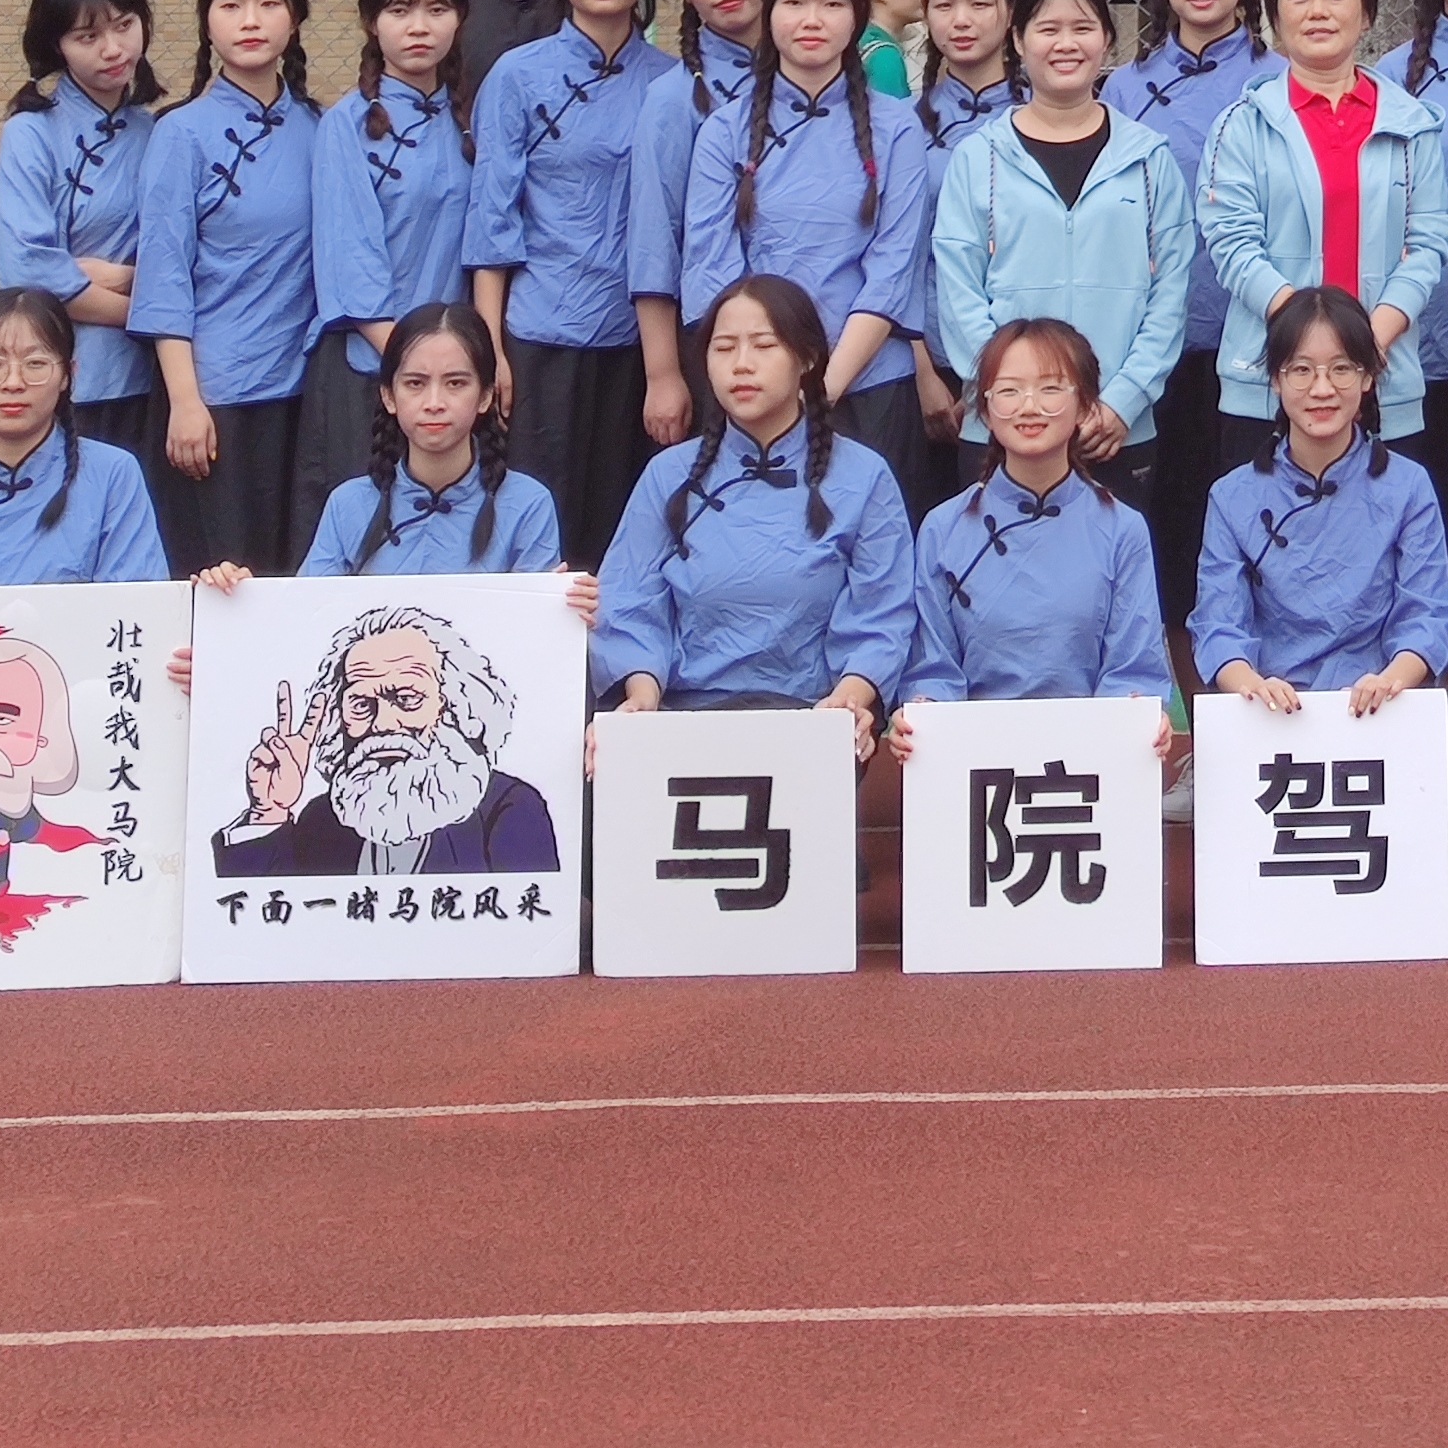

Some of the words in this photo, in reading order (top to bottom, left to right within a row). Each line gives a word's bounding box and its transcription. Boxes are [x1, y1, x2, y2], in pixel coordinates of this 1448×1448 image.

[100, 618, 144, 886] 壮哉我大马院
[655, 775, 792, 912] 马
[968, 759, 1108, 908] 院
[1254, 752, 1390, 896] 驾
[216, 882, 552, 925] 下面一睹马院风采
